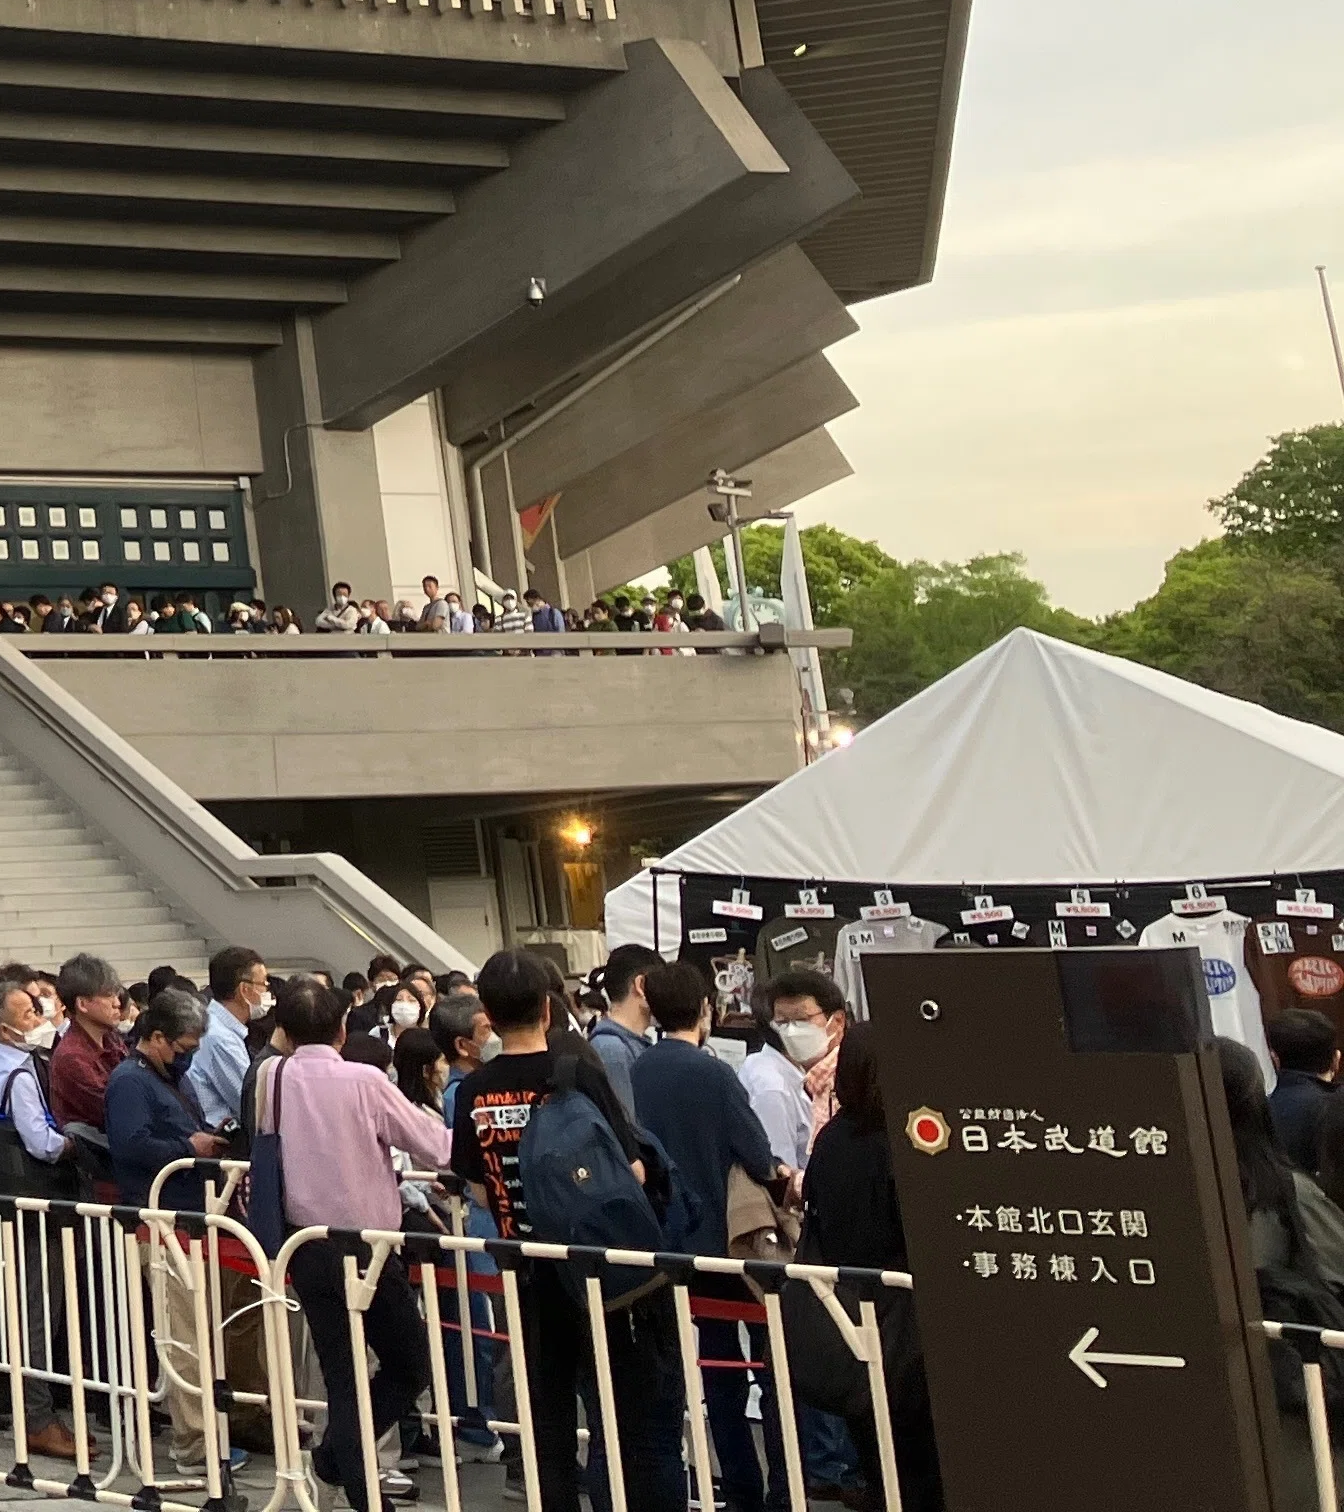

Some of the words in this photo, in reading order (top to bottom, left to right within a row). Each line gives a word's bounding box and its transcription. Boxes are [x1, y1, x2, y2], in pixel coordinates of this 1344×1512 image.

[804, 891, 814, 905] 2
[879, 891, 889, 906] 3
[1076, 890, 1086, 904] 5
[1191, 885, 1201, 899] 6
[1300, 891, 1310, 904] 7
[980, 897, 989, 910] 4
[1051, 922, 1063, 934] M
[1261, 925, 1271, 937] S
[1275, 924, 1287, 938] M
[860, 933, 872, 944] M
[1053, 937, 1066, 947] XL
[1172, 931, 1186, 943] M
[1265, 939, 1274, 951] L
[1277, 938, 1292, 950] XL
[850, 948, 858, 960] L
[962, 1123, 1168, 1158] 日本武道館
